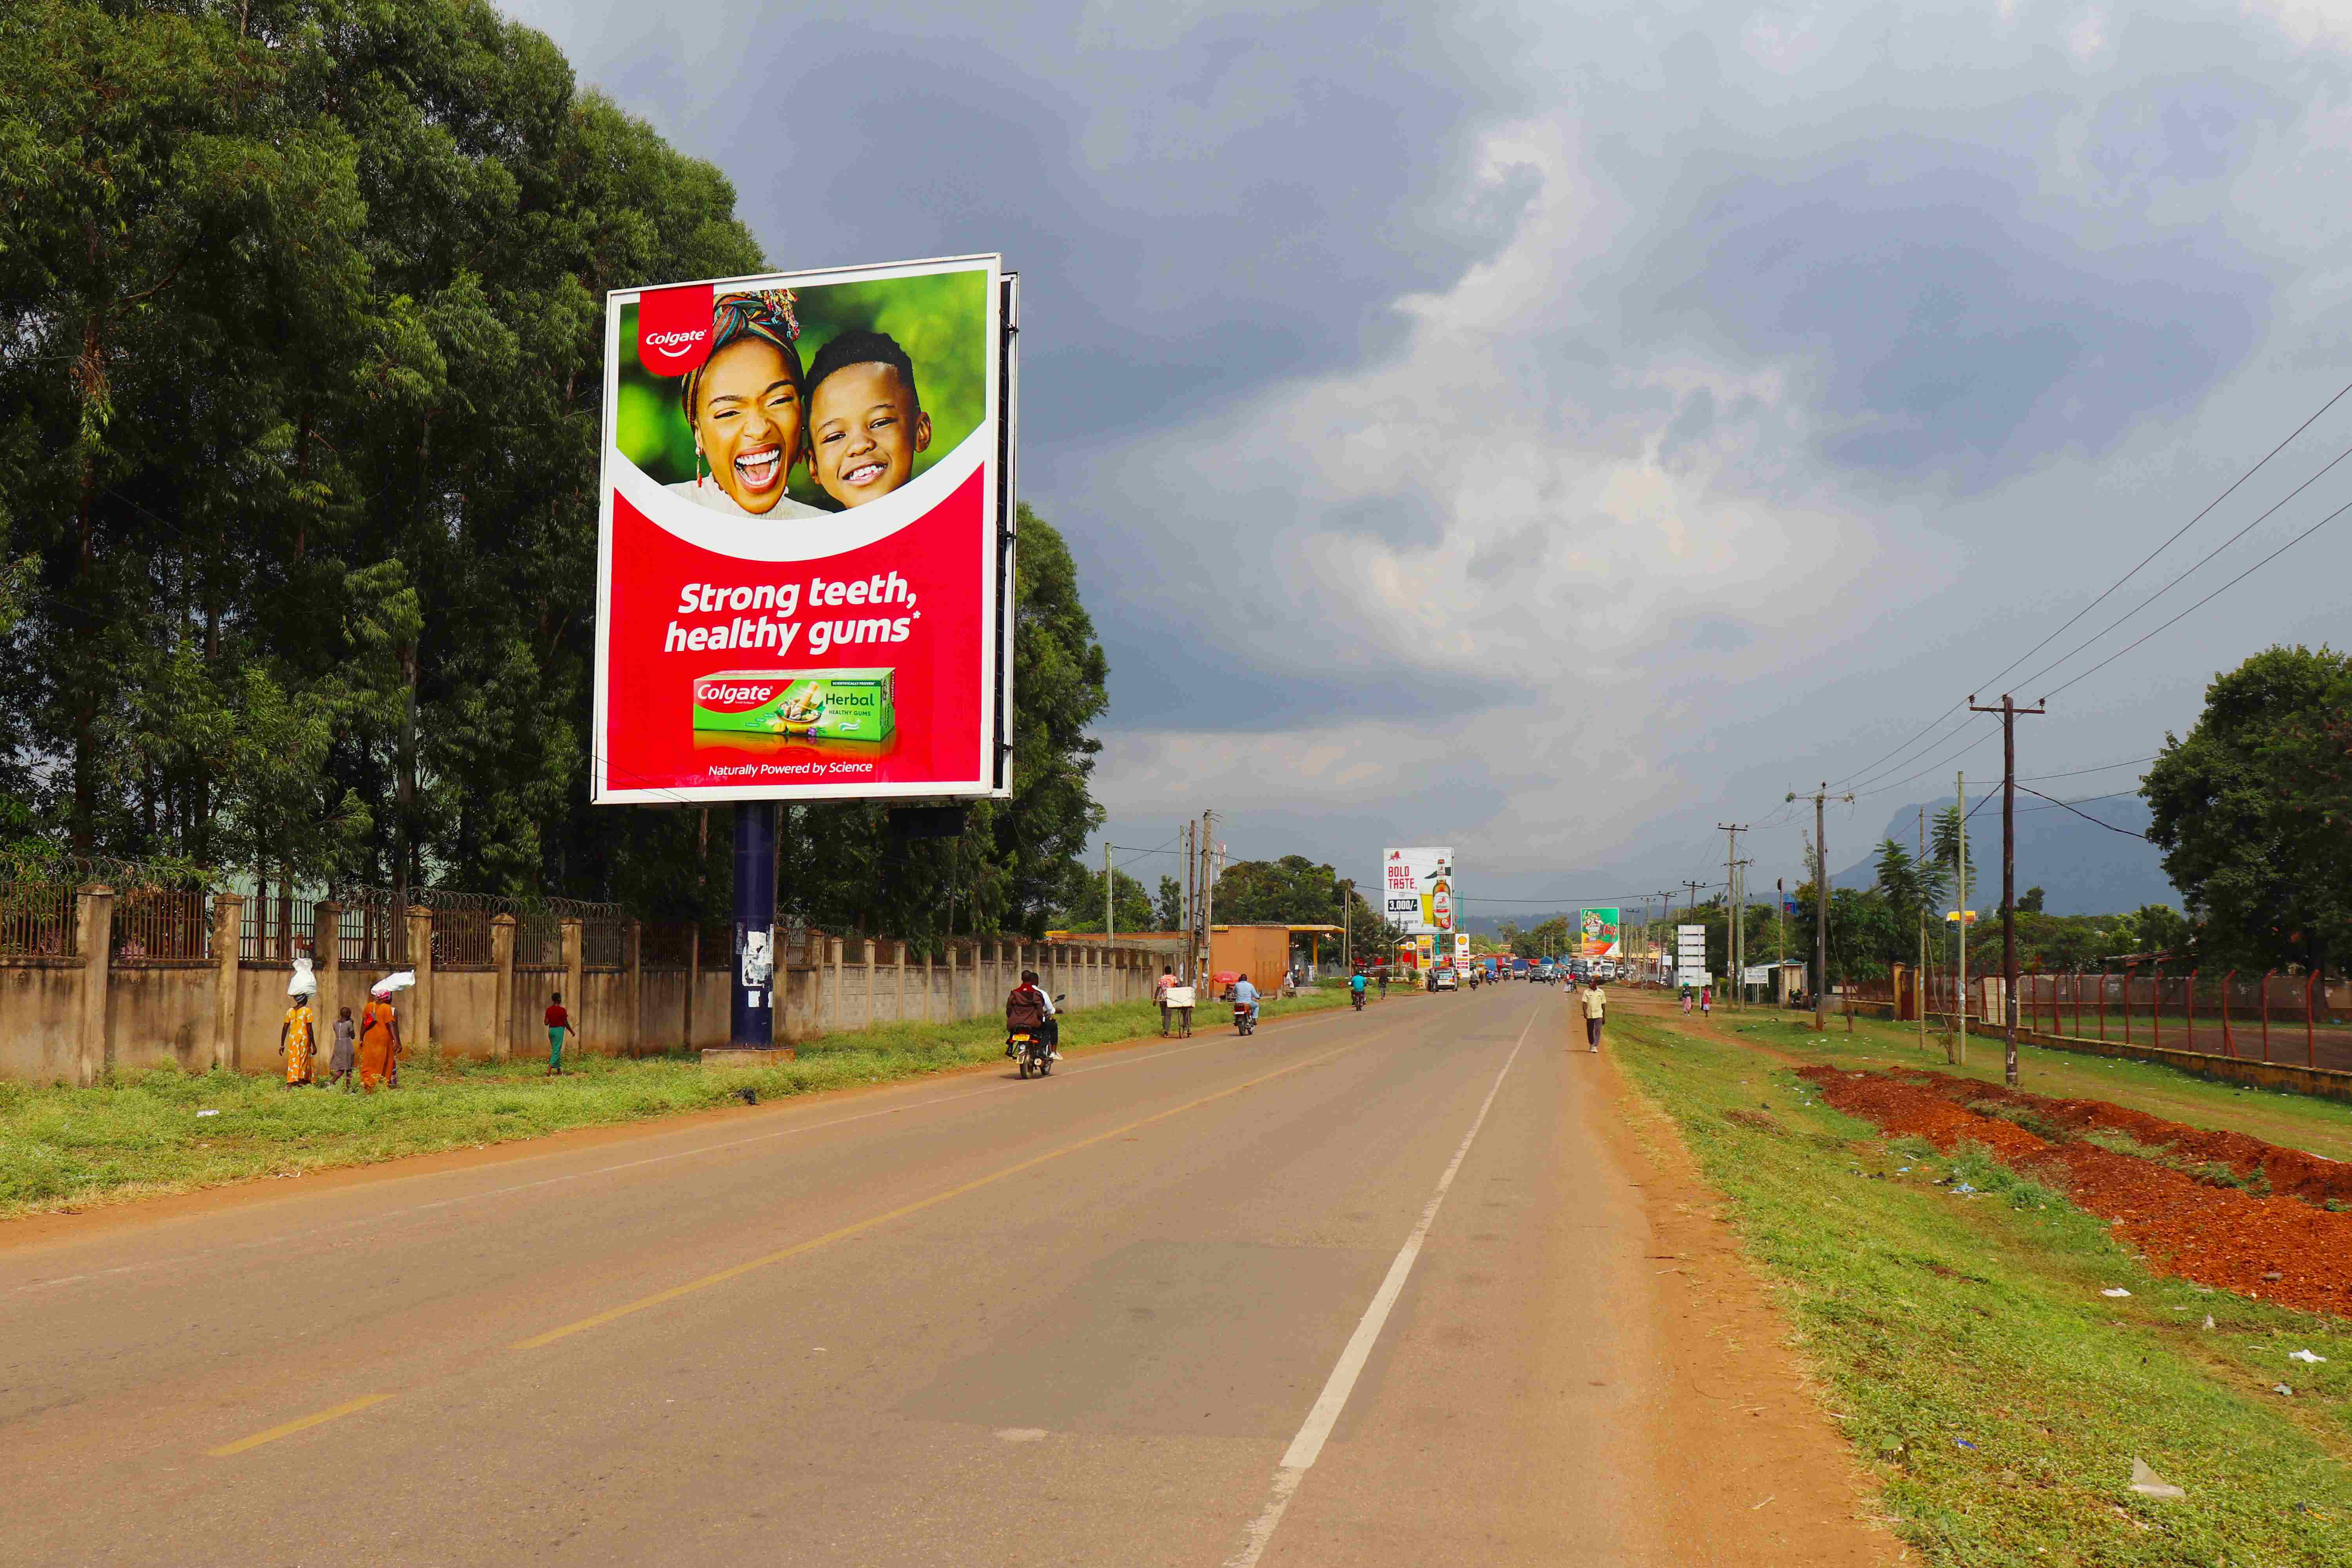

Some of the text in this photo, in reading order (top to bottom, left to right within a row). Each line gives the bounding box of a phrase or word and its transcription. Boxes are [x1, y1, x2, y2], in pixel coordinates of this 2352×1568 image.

[646, 330, 705, 347] Colgate
[678, 570, 916, 618] Strong teeth,
[664, 615, 802, 657] healthy
[697, 684, 771, 704] Colgate
[826, 693, 875, 706] Herbal
[708, 761, 873, 777] Naturally Powered by Science
[1388, 866, 1410, 877] BOLD
[1388, 878, 1417, 890] TASTE,
